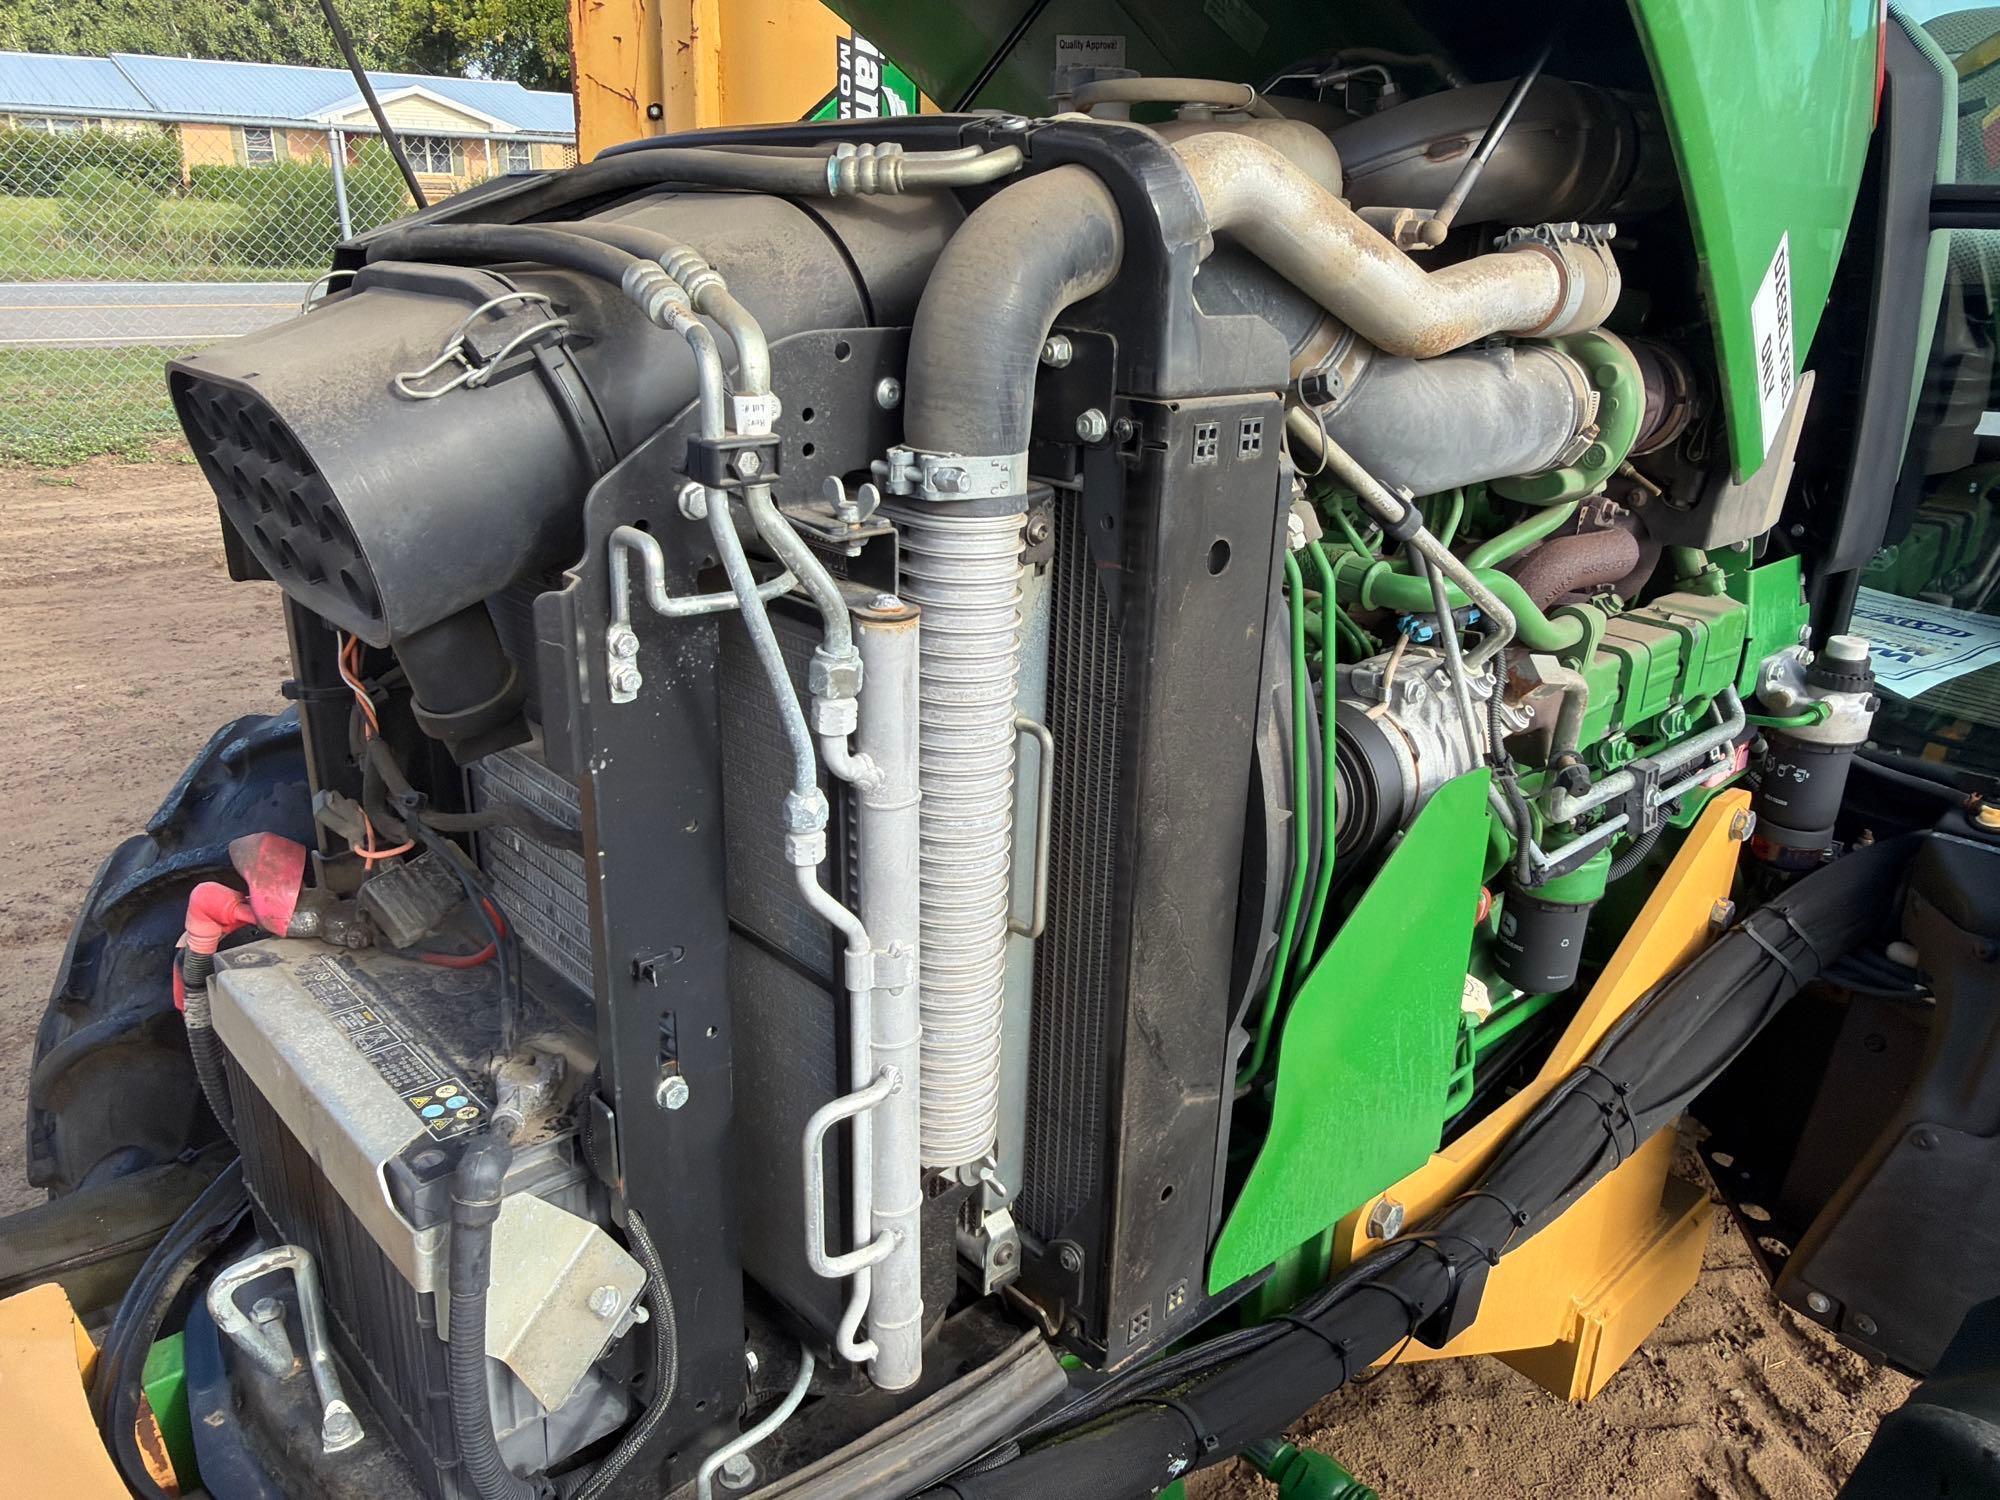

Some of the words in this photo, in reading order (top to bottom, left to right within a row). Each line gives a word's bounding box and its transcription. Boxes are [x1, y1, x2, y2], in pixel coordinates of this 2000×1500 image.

[1059, 39, 1084, 52] Quality
[1086, 40, 1118, 51] Approval
[1774, 246, 1789, 353] DIESEL
[1762, 332, 1775, 401] ONLY
[1779, 341, 1791, 411] FUEL
